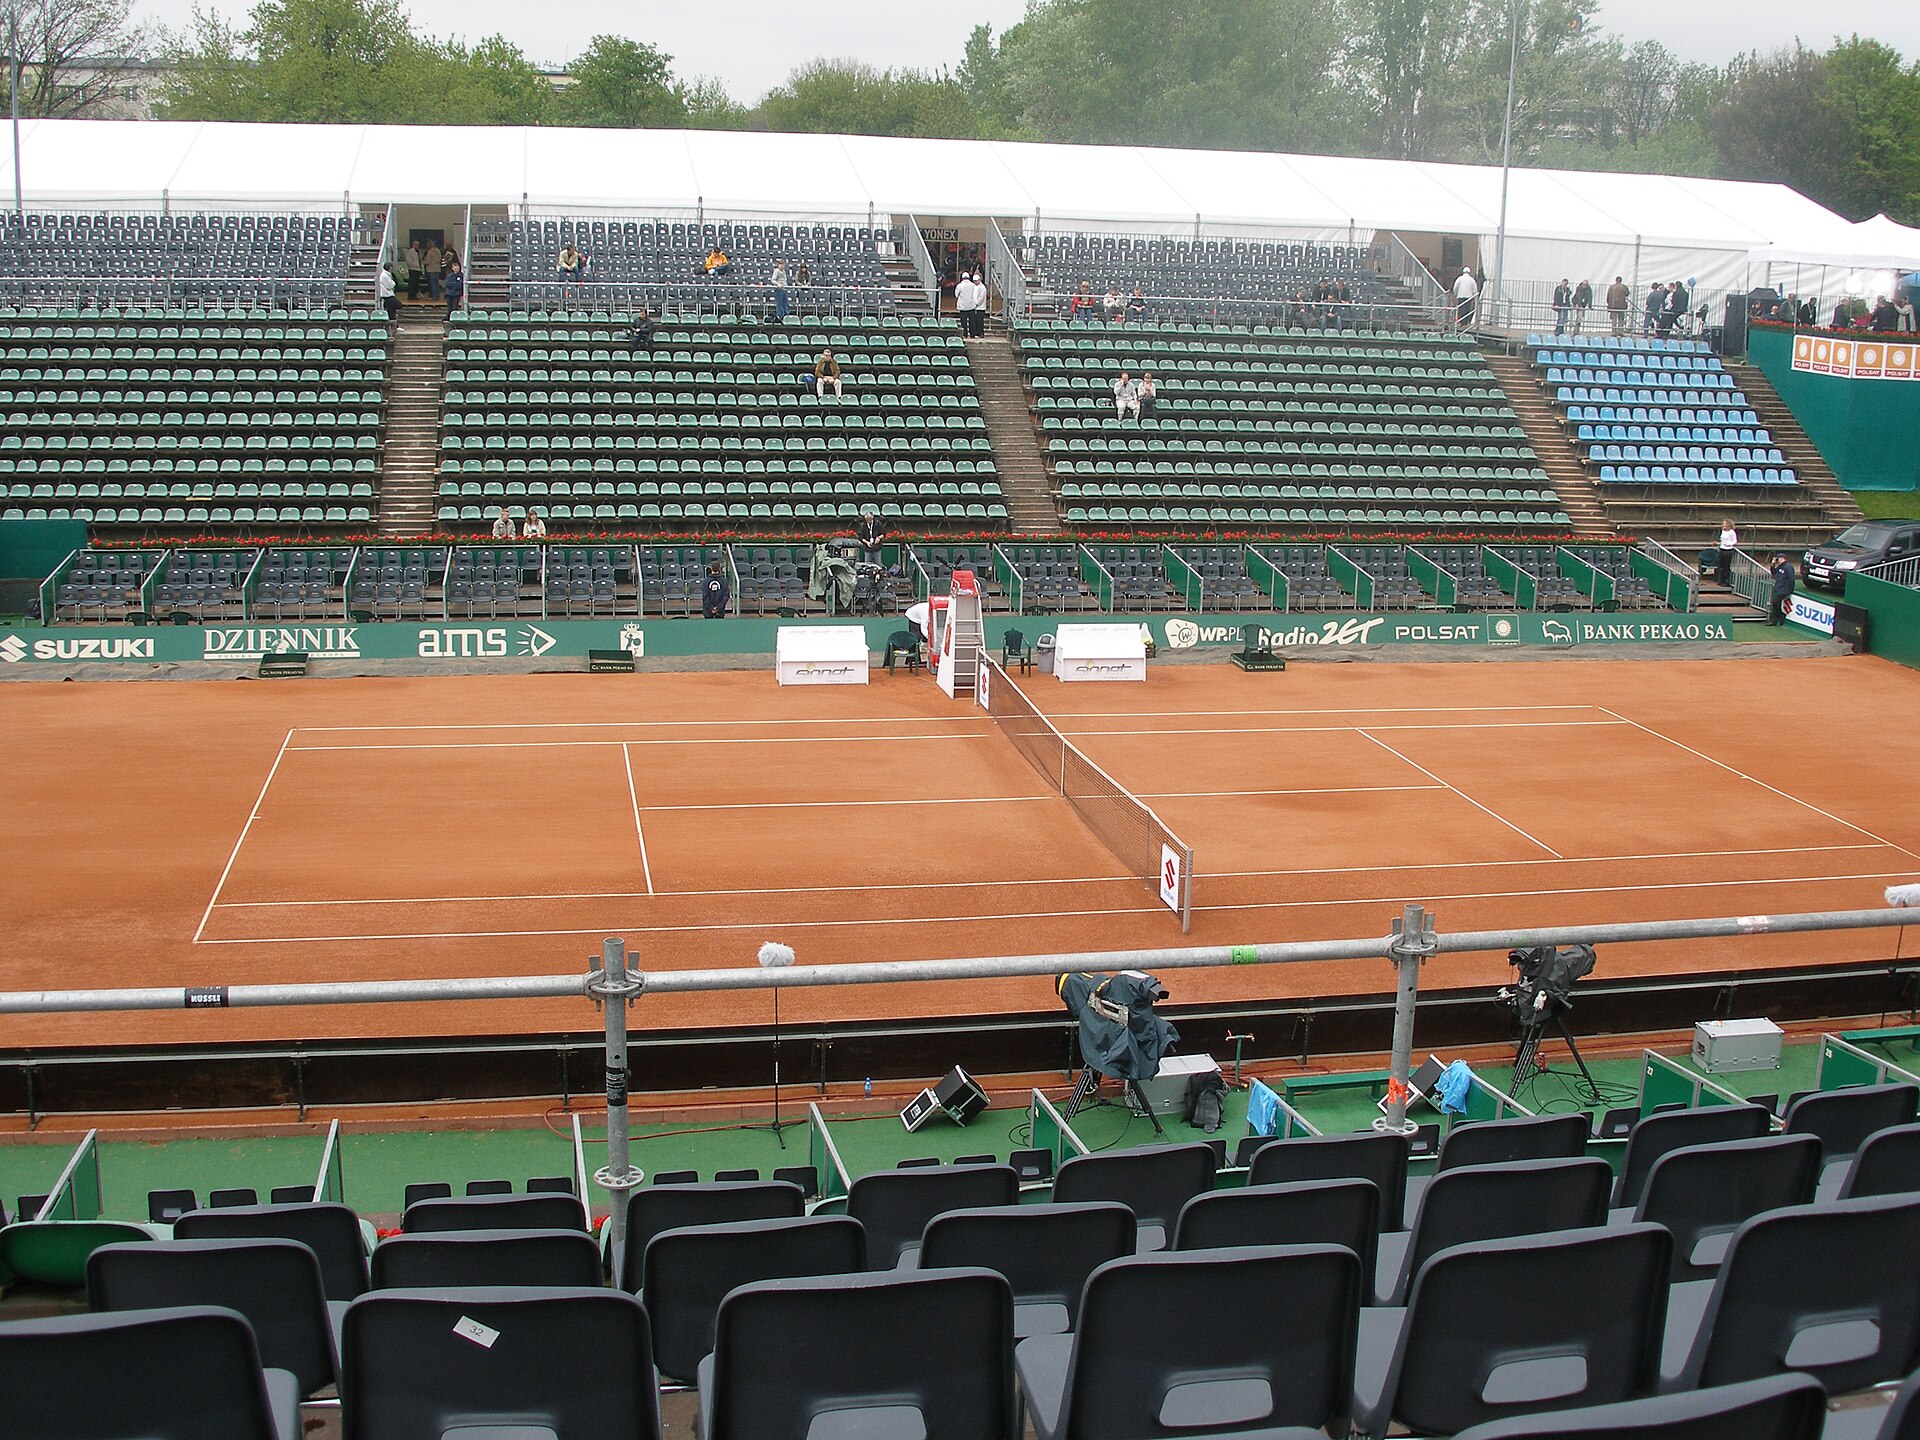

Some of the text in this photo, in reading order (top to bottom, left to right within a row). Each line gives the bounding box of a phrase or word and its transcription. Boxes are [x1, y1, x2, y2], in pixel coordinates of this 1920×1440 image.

[924, 229, 956, 240] YONEX
[1795, 604, 1835, 626] SUZUK
[204, 628, 360, 652] DZIENNIK
[1199, 627, 1243, 642] WP.PL
[1395, 625, 1480, 640] POLSAT
[1583, 624, 1727, 640] BANK PEKAO SA
[33, 639, 154, 659] SUZUKI
[418, 629, 507, 657] ams
[469, 1325, 484, 1337] 32
